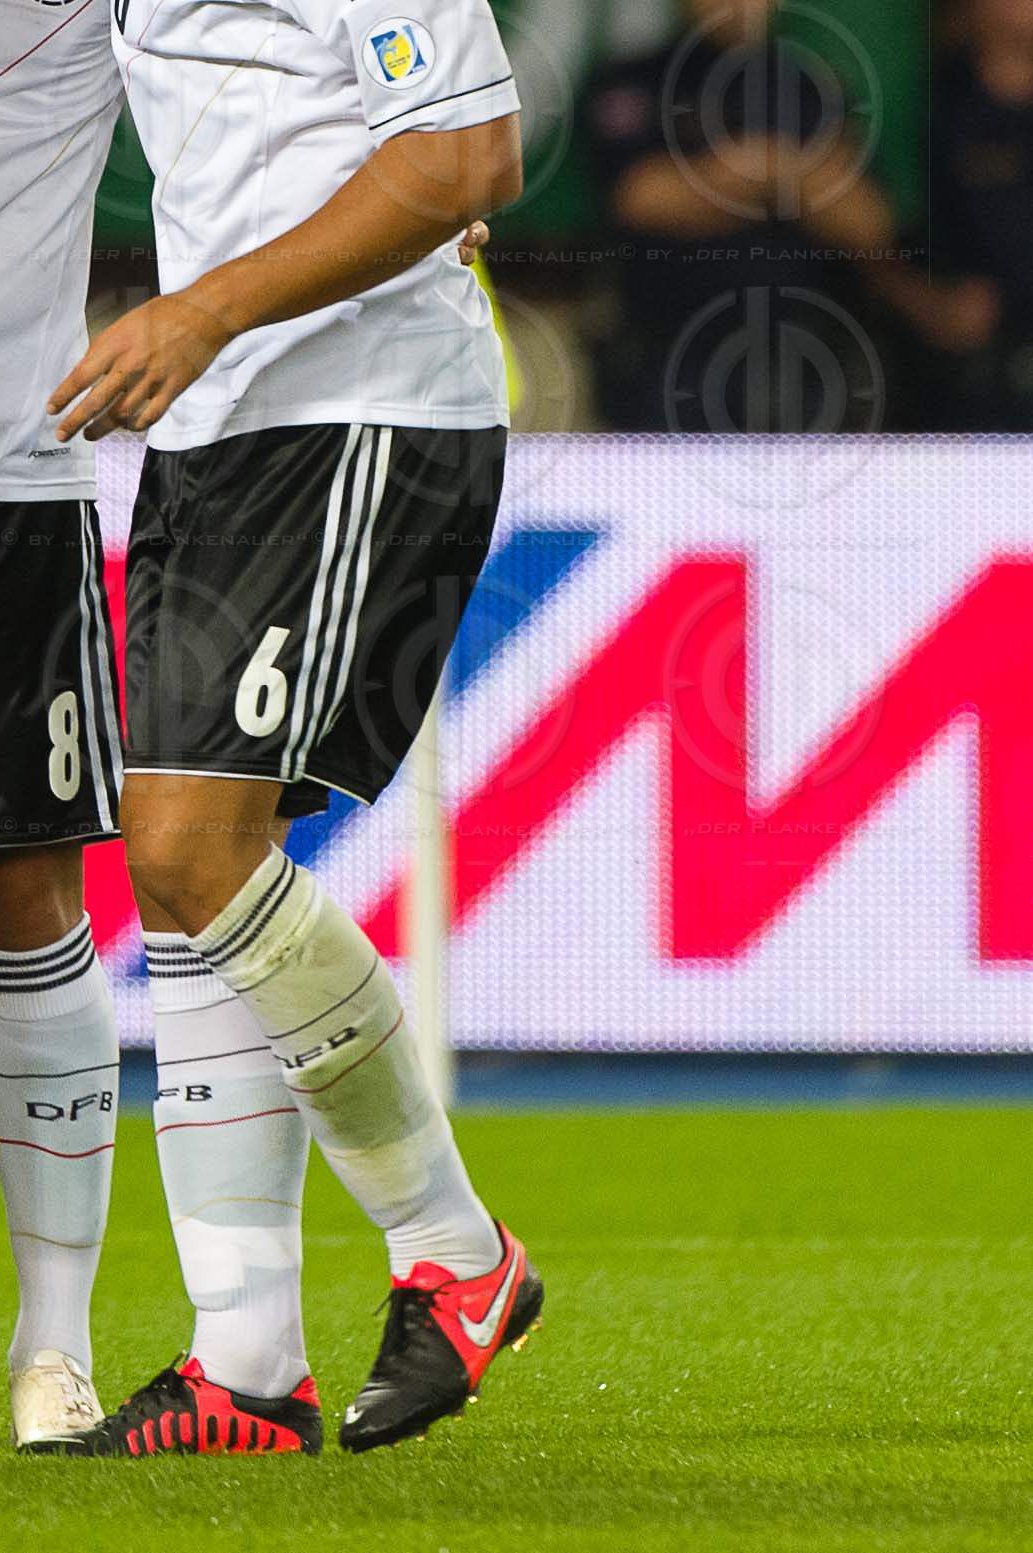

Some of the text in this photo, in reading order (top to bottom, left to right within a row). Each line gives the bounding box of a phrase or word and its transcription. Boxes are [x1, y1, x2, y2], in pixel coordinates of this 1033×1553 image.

[234, 625, 291, 738] 6
[48, 690, 81, 801] 8
[26, 1091, 113, 1122] DFB
